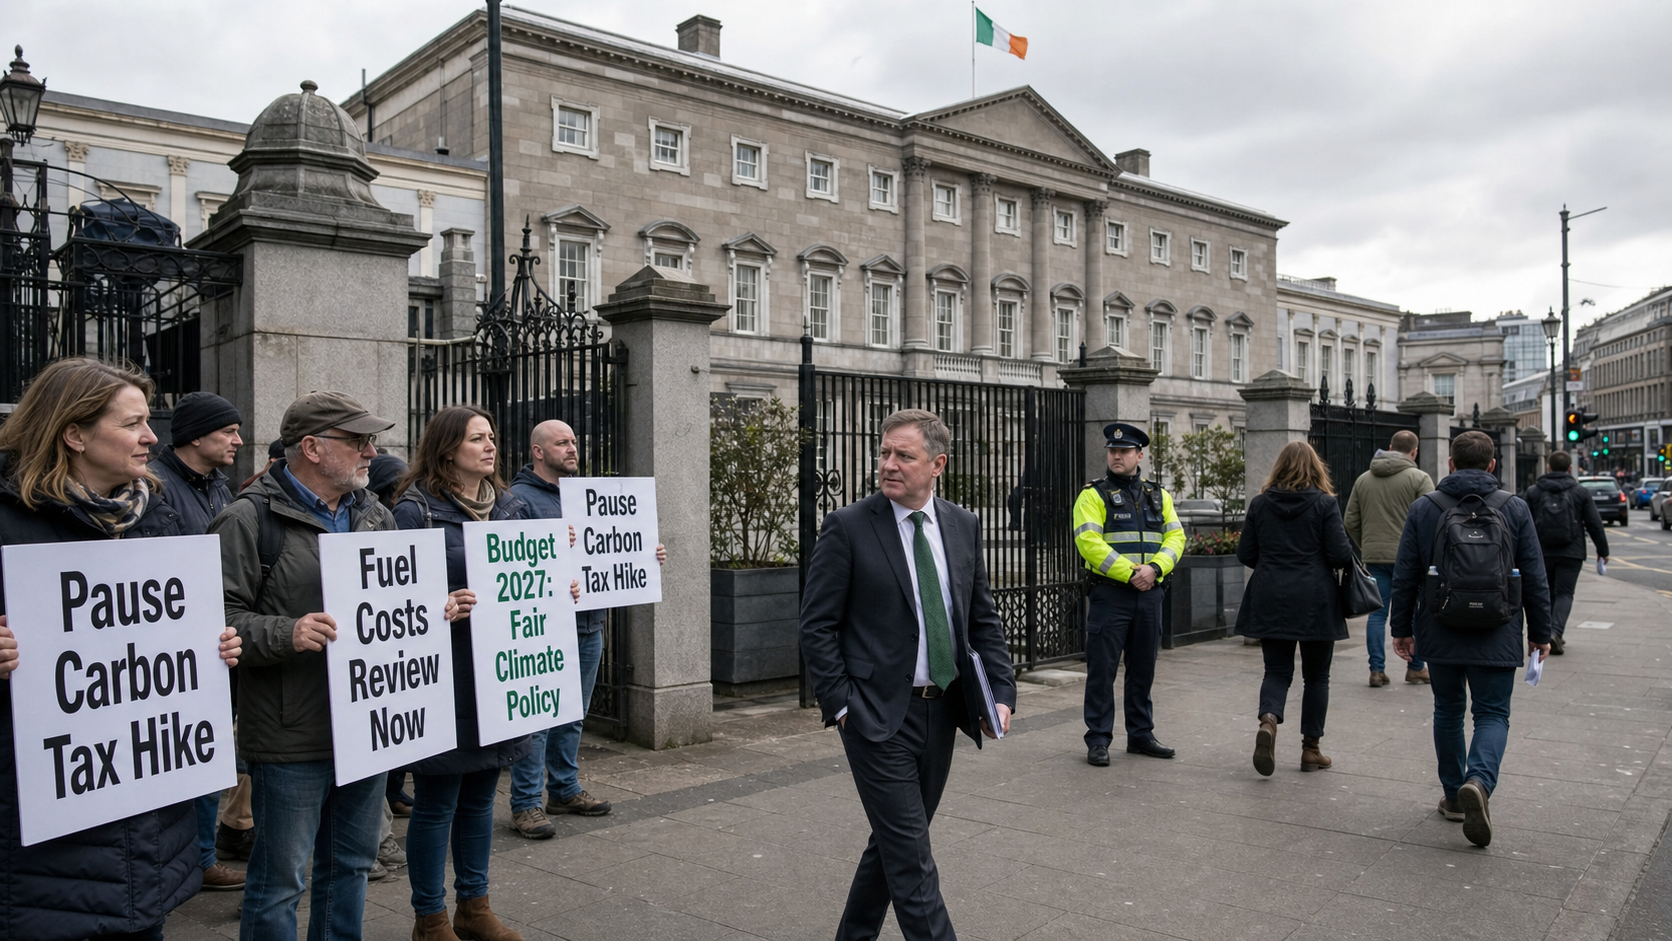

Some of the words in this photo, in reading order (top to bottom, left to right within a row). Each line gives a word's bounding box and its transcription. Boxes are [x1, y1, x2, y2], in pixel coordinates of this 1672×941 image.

[586, 489, 636, 516] Pause
[487, 532, 556, 567] Budget
[584, 526, 642, 555] Carbon
[360, 545, 417, 589] Fuel
[582, 566, 609, 593] Tax
[614, 563, 646, 590] Hike
[60, 571, 185, 632] Pause
[497, 570, 553, 602] 2027:
[356, 599, 428, 645] Costs
[510, 607, 546, 640] Fair
[55, 643, 198, 714] Carbon
[349, 650, 439, 703] Review
[496, 646, 564, 682] Climate
[507, 685, 560, 721] Policy
[370, 707, 425, 751] Now
[43, 734, 121, 799] Tax
[131, 712, 214, 780] Hike
